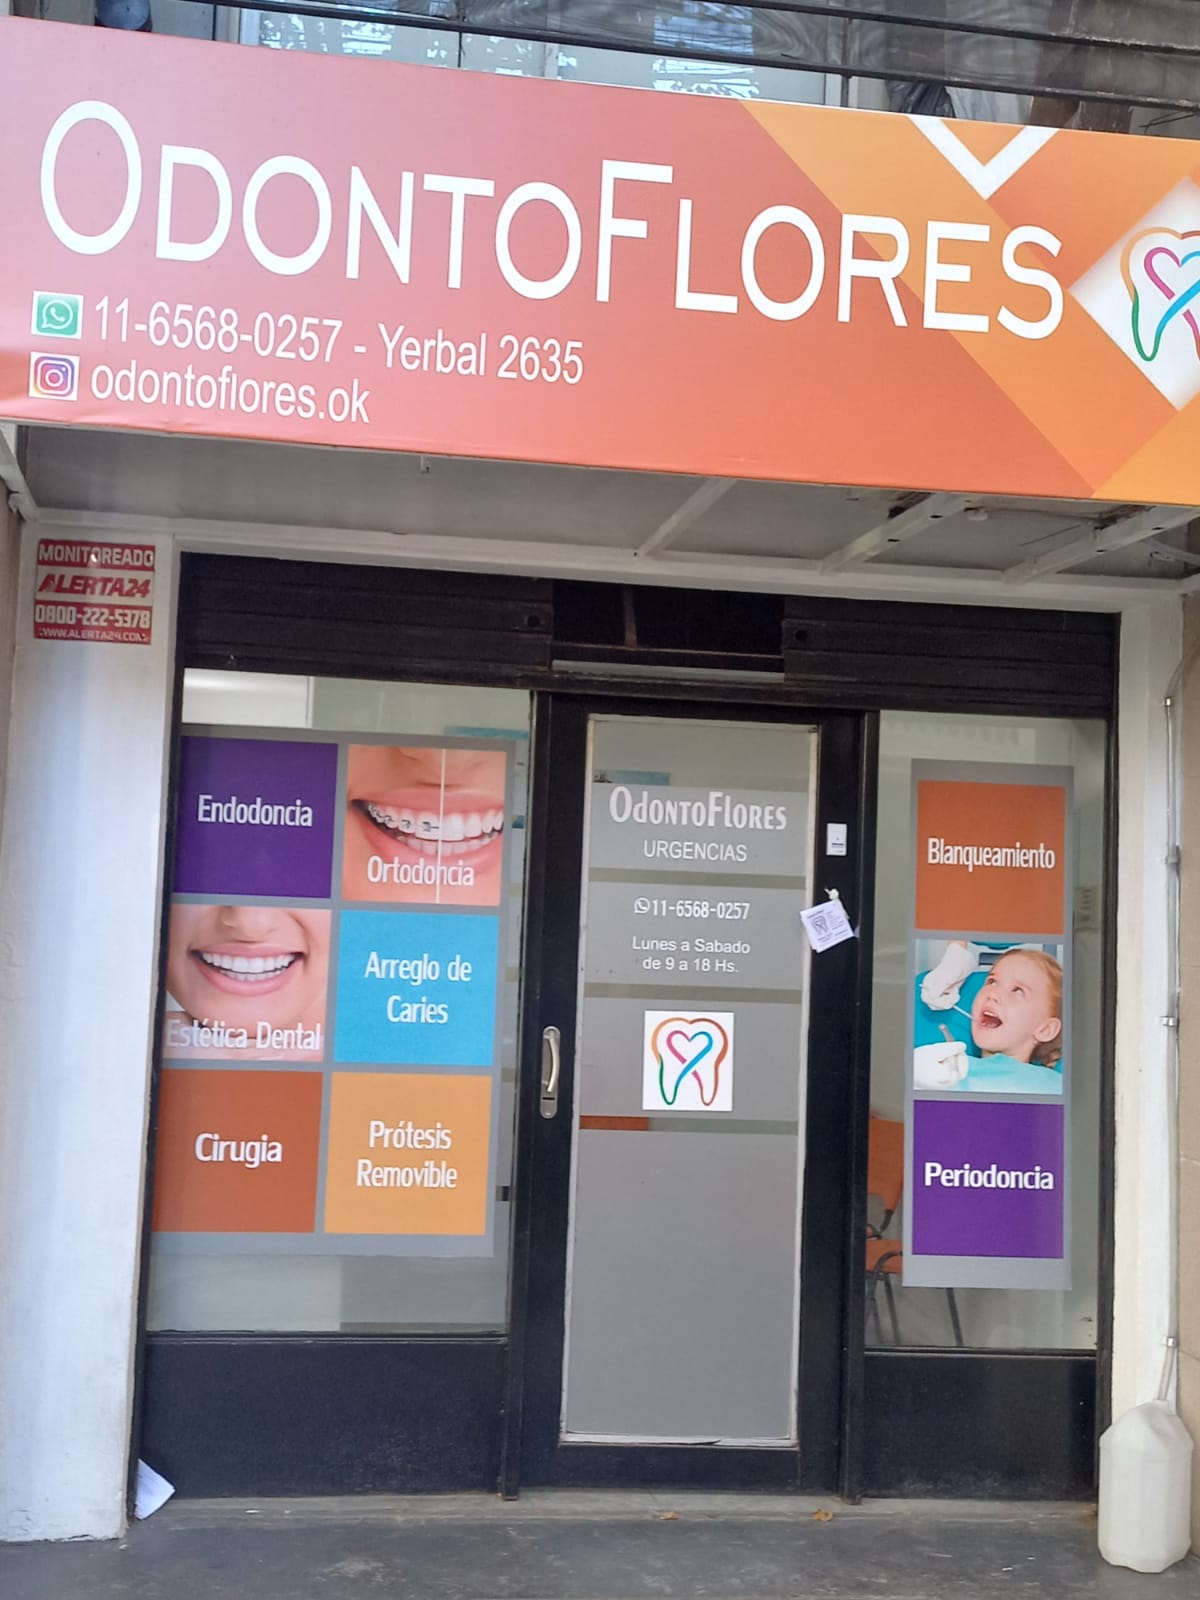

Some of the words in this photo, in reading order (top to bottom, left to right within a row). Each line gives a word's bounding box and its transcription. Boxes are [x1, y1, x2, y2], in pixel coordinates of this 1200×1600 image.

[94, 295, 344, 364] 11-6568-0257
[377, 323, 487, 376] Yerbal
[496, 333, 584, 384] 2635
[91, 360, 371, 424] odontoflores.ok
[38, 543, 154, 567] MONITOREADO
[38, 573, 152, 598] ALERTA24
[35, 604, 151, 629] 0800-222-5378
[197, 794, 313, 827] Endodoncia
[643, 839, 748, 862] URGENCIAS
[927, 837, 1056, 871] Blanqueamiento
[366, 855, 475, 887] Ortodoncia
[652, 899, 751, 920] 11-6568-0257
[632, 936, 677, 951] Lunes
[680, 939, 690, 952] a
[694, 938, 751, 954] Sabado
[364, 951, 440, 986] Arreglo
[447, 955, 472, 982] de
[642, 956, 661, 970] de
[665, 956, 675, 971] 9
[679, 959, 689, 971] a
[694, 957, 712, 972] 18
[715, 957, 740, 973] Hs.
[386, 995, 449, 1025] Caries
[166, 1019, 247, 1049] Estética
[256, 1021, 321, 1050] Dental
[368, 1120, 452, 1150] Prótesis
[194, 1133, 283, 1168] Cirugia
[356, 1159, 458, 1189] Removible
[924, 1161, 1055, 1191] Periodoncia
